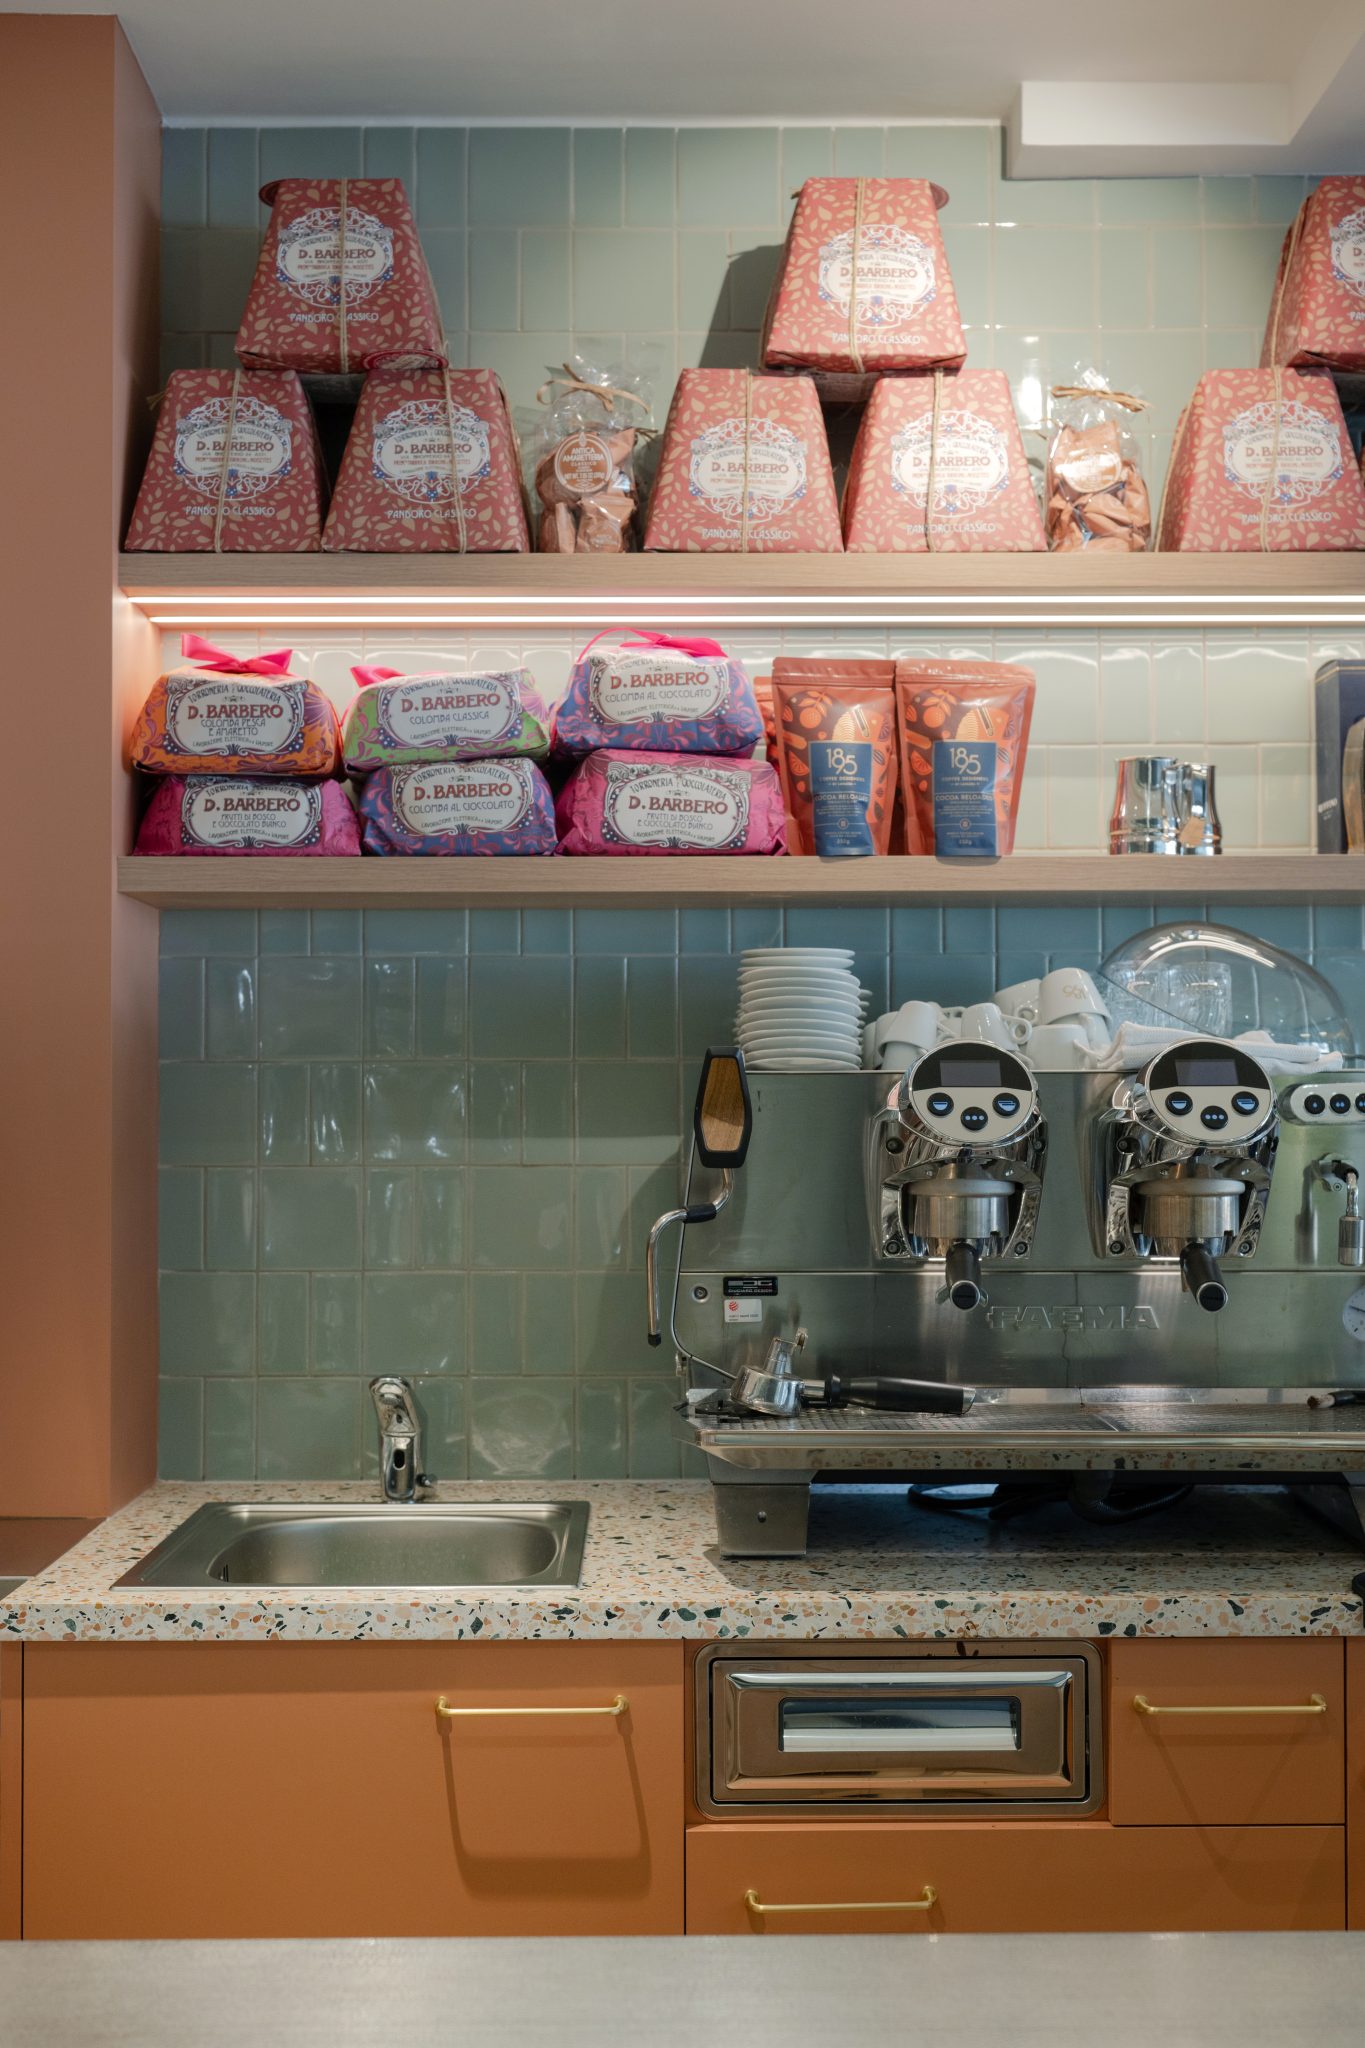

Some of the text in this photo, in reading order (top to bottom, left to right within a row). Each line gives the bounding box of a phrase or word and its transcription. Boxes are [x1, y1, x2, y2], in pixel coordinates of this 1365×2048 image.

[298, 249, 312, 259] D.
[856, 267, 918, 278] BARBERO
[289, 313, 335, 322] PANDORO
[196, 441, 210, 451] D.
[394, 444, 408, 455] D.
[1245, 447, 1259, 457] D.
[711, 462, 725, 472] D.
[913, 456, 927, 467] D.
[231, 506, 275, 516] CLASSICO
[387, 510, 433, 519] PANDORO
[610, 671, 709, 689] D. BARBERO
[605, 689, 711, 703] COLOMBA AL CIOCCOLATO
[401, 693, 501, 713] D. BARBERO
[188, 704, 284, 719] D. BARBERO
[201, 718, 266, 728] COLOMBA PESCA
[410, 711, 489, 725] COLOMBA CLASSICA
[208, 727, 258, 736] E AMARETTO
[414, 783, 513, 801] D. BARBERO
[203, 798, 300, 812] D. BARBERO
[409, 800, 514, 815] COLOMBA AL CIOCCOLATO
[628, 795, 728, 815] D. BARBERO
[646, 812, 669, 820] FRUTTI
[679, 814, 703, 822] BOSCO
[218, 820, 260, 828] CIOCCOLATO
[644, 820, 687, 829] CIOCCOLATO
[688, 822, 714, 831] BIANCO
[987, 1305, 1160, 1329] FAEMA
